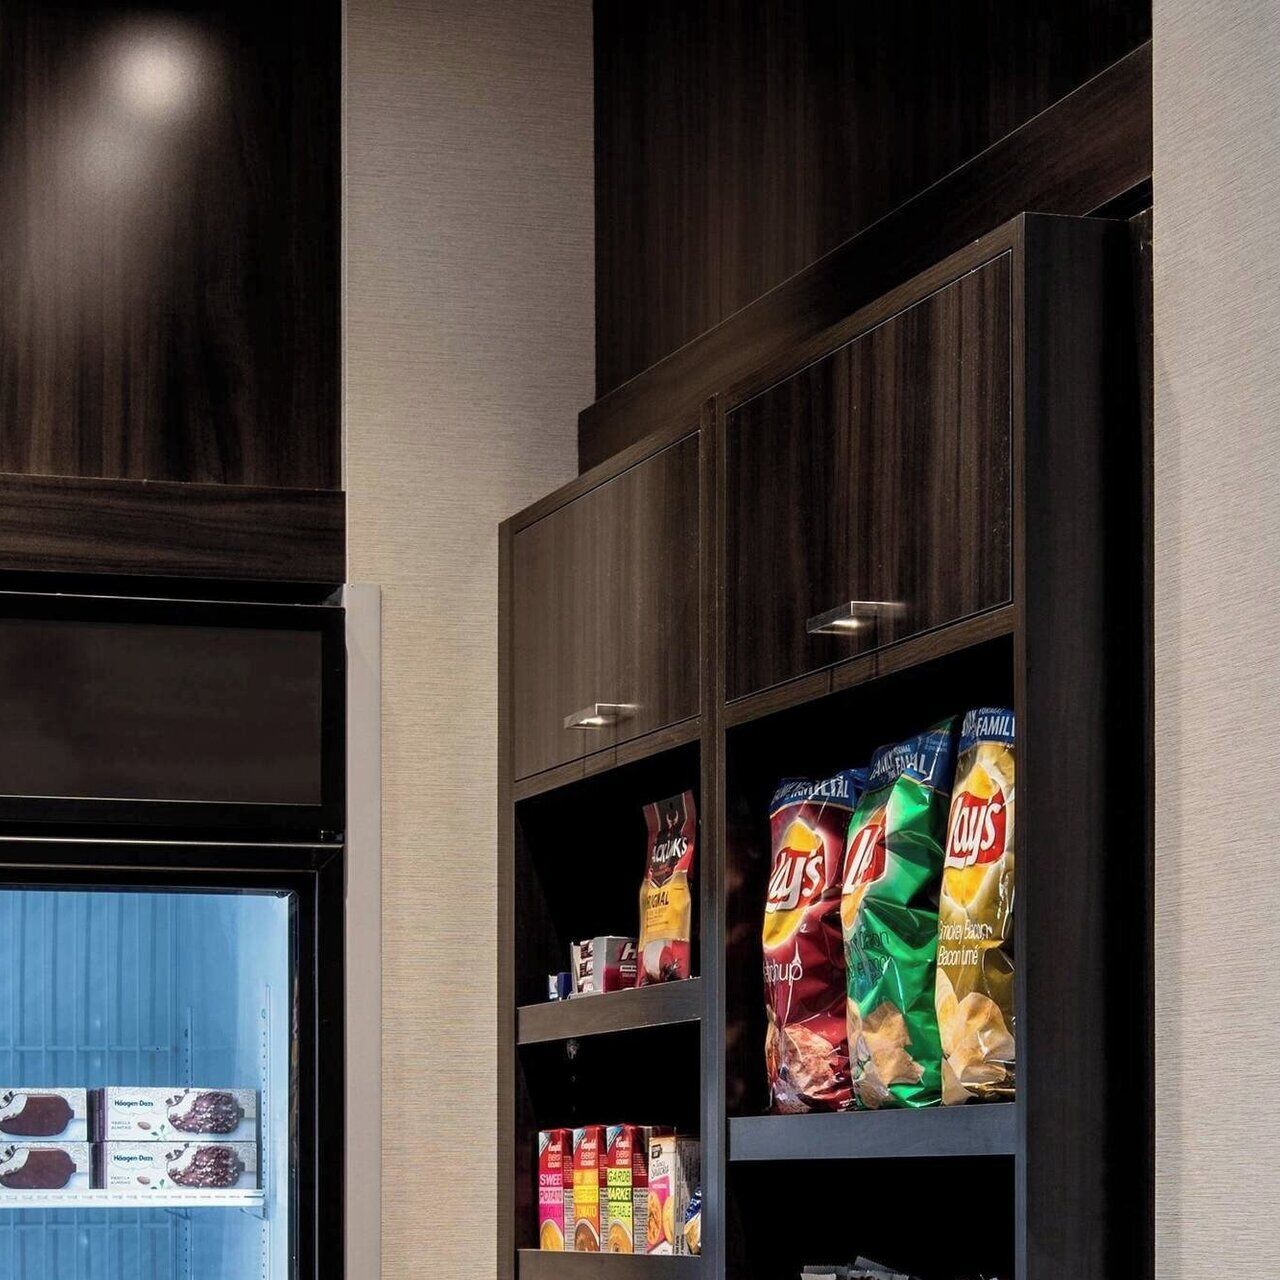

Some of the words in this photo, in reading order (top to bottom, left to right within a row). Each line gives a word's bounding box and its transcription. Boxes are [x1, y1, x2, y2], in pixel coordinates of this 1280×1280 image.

[946, 797, 1003, 870] Lay's
[938, 946, 960, 965] Bacon
[540, 1174, 561, 1185] SWEE
[608, 1187, 631, 1200] MARKE
